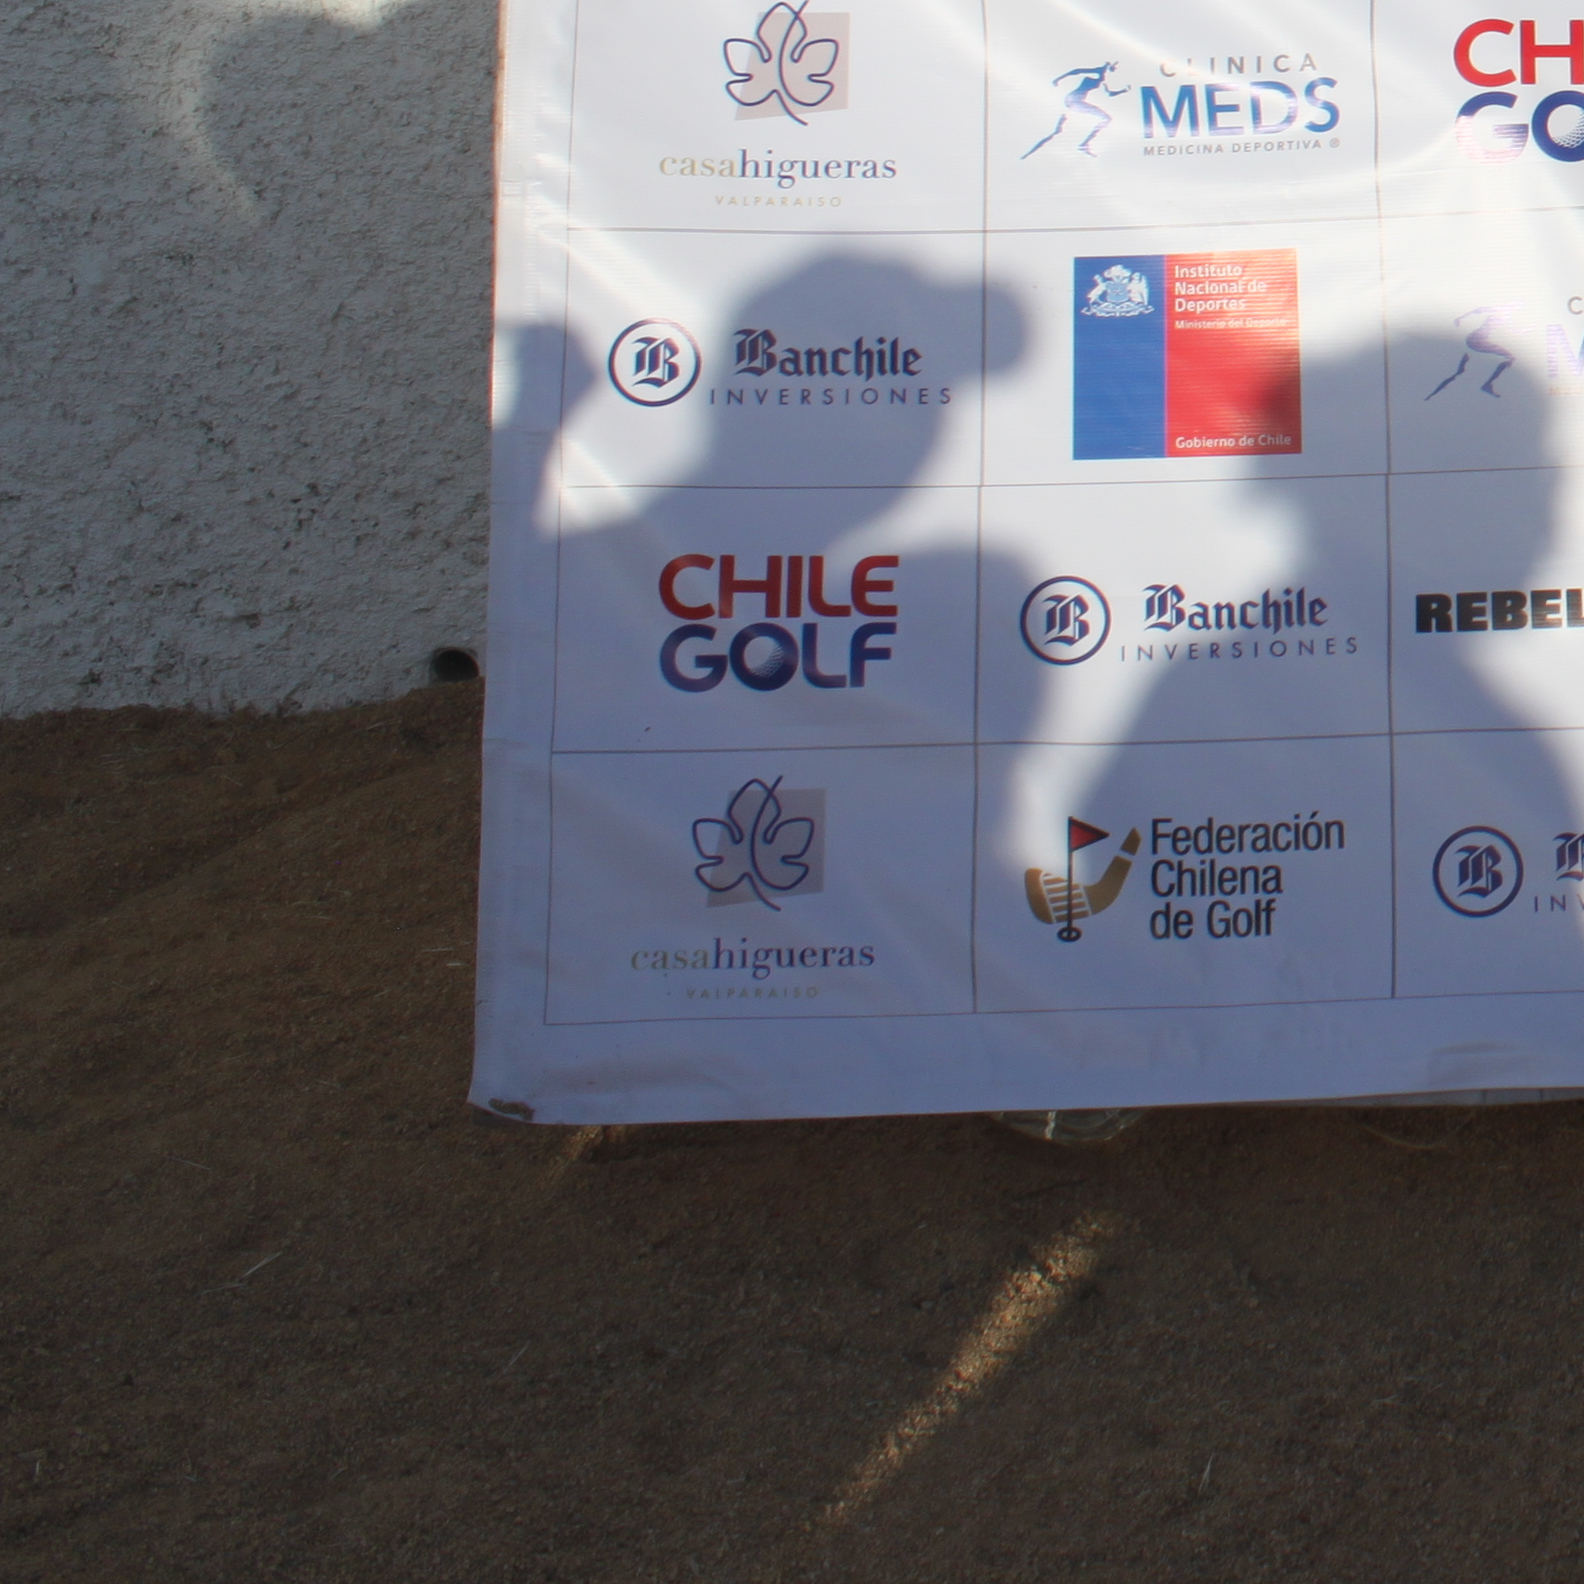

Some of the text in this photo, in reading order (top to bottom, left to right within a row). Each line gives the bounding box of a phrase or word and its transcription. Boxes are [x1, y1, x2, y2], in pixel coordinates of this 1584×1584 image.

[1139, 77, 1341, 140] MEDS
[658, 148, 898, 190] casahigueras
[1143, 138, 1322, 158] MEDICINA DEPORTIVA
[714, 194, 843, 208] VALPARAISO
[1174, 264, 1243, 279] Instituto
[1174, 279, 1267, 296] Nacional de
[1174, 297, 1246, 315] Deportes
[733, 327, 923, 383] Banchile
[709, 386, 951, 407] INVERSIONES
[1175, 433, 1292, 449] Gobierno de Chile
[658, 553, 899, 621] CHILE
[1142, 583, 1328, 636] Banchile
[659, 622, 897, 693] GOLF
[1120, 636, 1359, 663] INVERSIONES
[1150, 811, 1346, 856] Federación
[1149, 857, 1283, 899] Chilena
[1149, 897, 1278, 941] de Golf
[630, 937, 876, 980] casahigueras
[685, 986, 819, 1000] VALPARAISO
